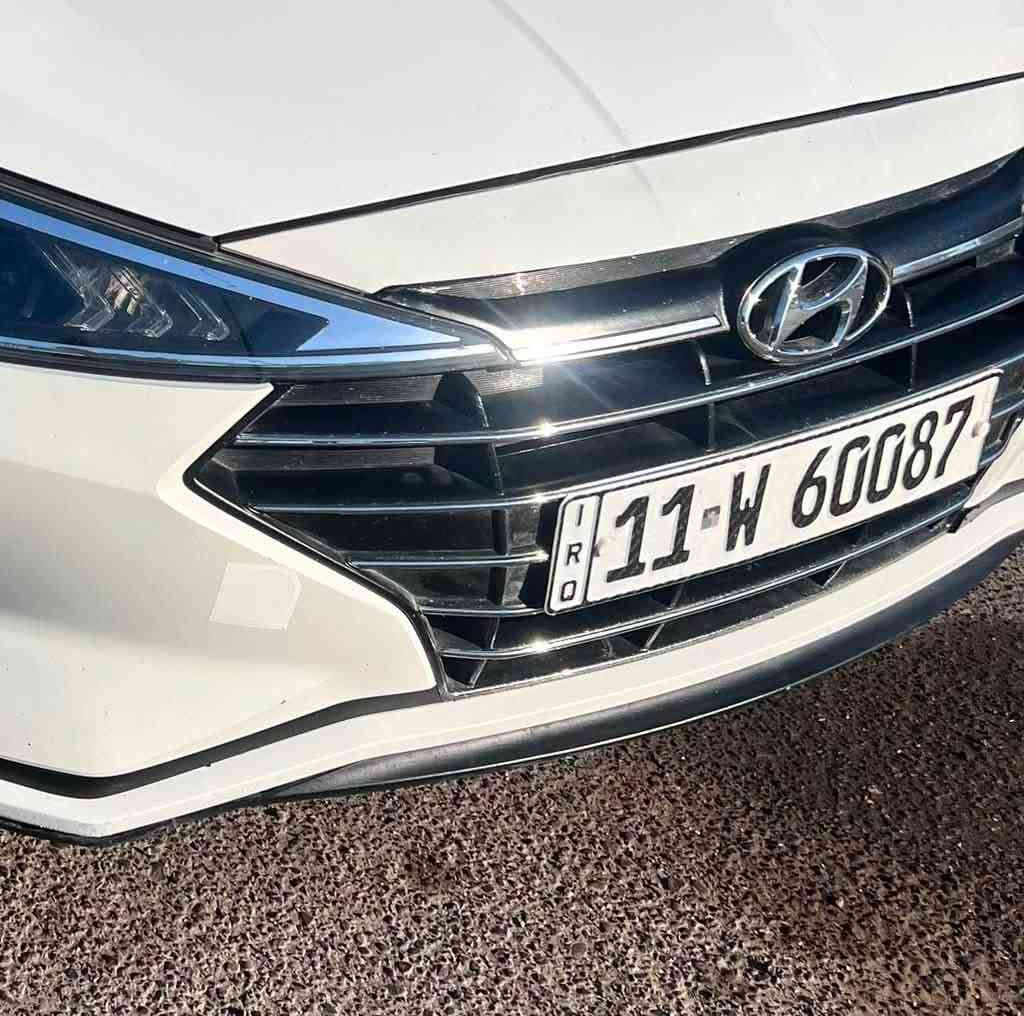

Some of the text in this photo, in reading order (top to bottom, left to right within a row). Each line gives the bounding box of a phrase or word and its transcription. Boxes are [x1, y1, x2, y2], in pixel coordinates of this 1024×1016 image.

[606, 484, 695, 582] 11
[726, 464, 771, 551] W
[791, 395, 974, 528] 60087
